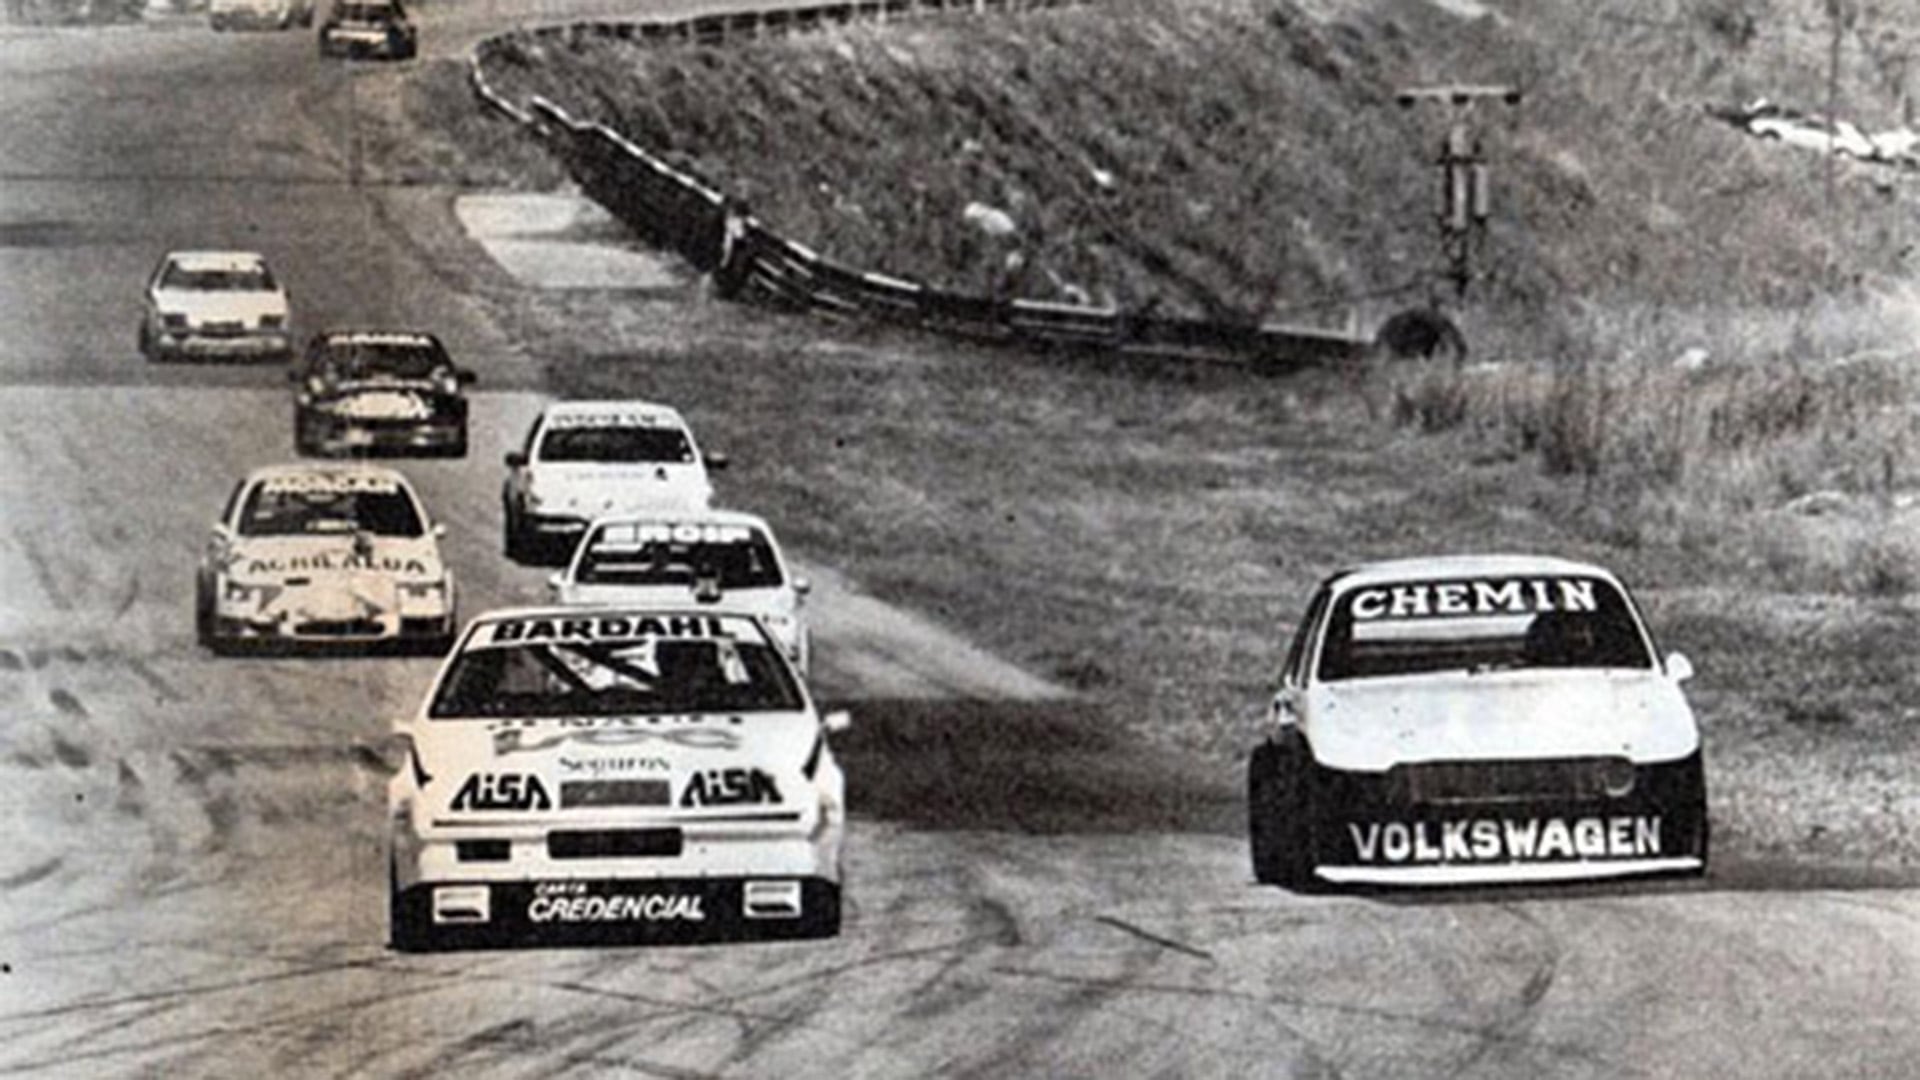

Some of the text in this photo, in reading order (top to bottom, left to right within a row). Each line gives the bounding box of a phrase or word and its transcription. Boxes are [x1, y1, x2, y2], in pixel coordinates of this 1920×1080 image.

[1351, 581, 1596, 618] CHEMIN
[493, 616, 736, 642] BARDAHL
[1349, 817, 1661, 861] VOLKSWAGEN
[528, 895, 705, 922] CREDENCIAL
